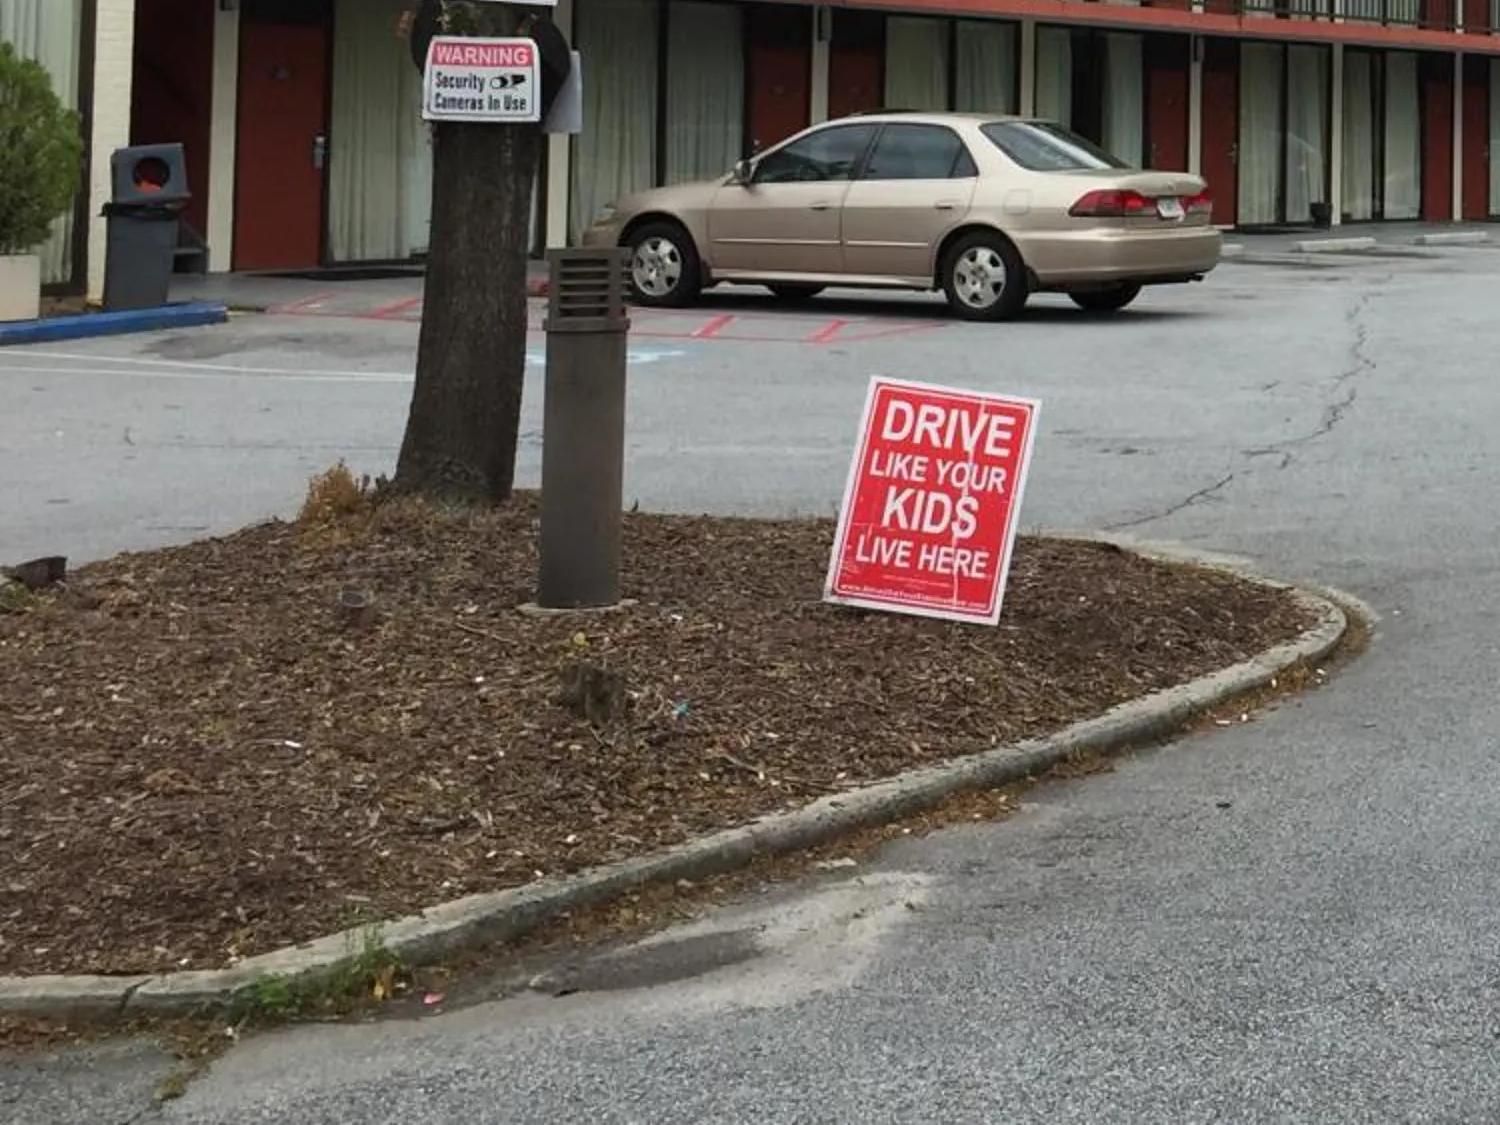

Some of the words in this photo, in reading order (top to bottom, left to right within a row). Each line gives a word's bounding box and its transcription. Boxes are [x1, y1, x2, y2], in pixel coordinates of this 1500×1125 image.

[436, 44, 530, 65] WARNING
[434, 92, 484, 110] Cameras
[488, 94, 499, 110] In
[503, 95, 527, 111] Use
[435, 71, 485, 93] Security
[881, 398, 1016, 457] DRIVE
[869, 450, 929, 482] LIKE
[936, 459, 1007, 494] YOUR
[881, 485, 980, 539] KIDS
[855, 534, 913, 568] LIVE
[917, 543, 990, 579] HERE
